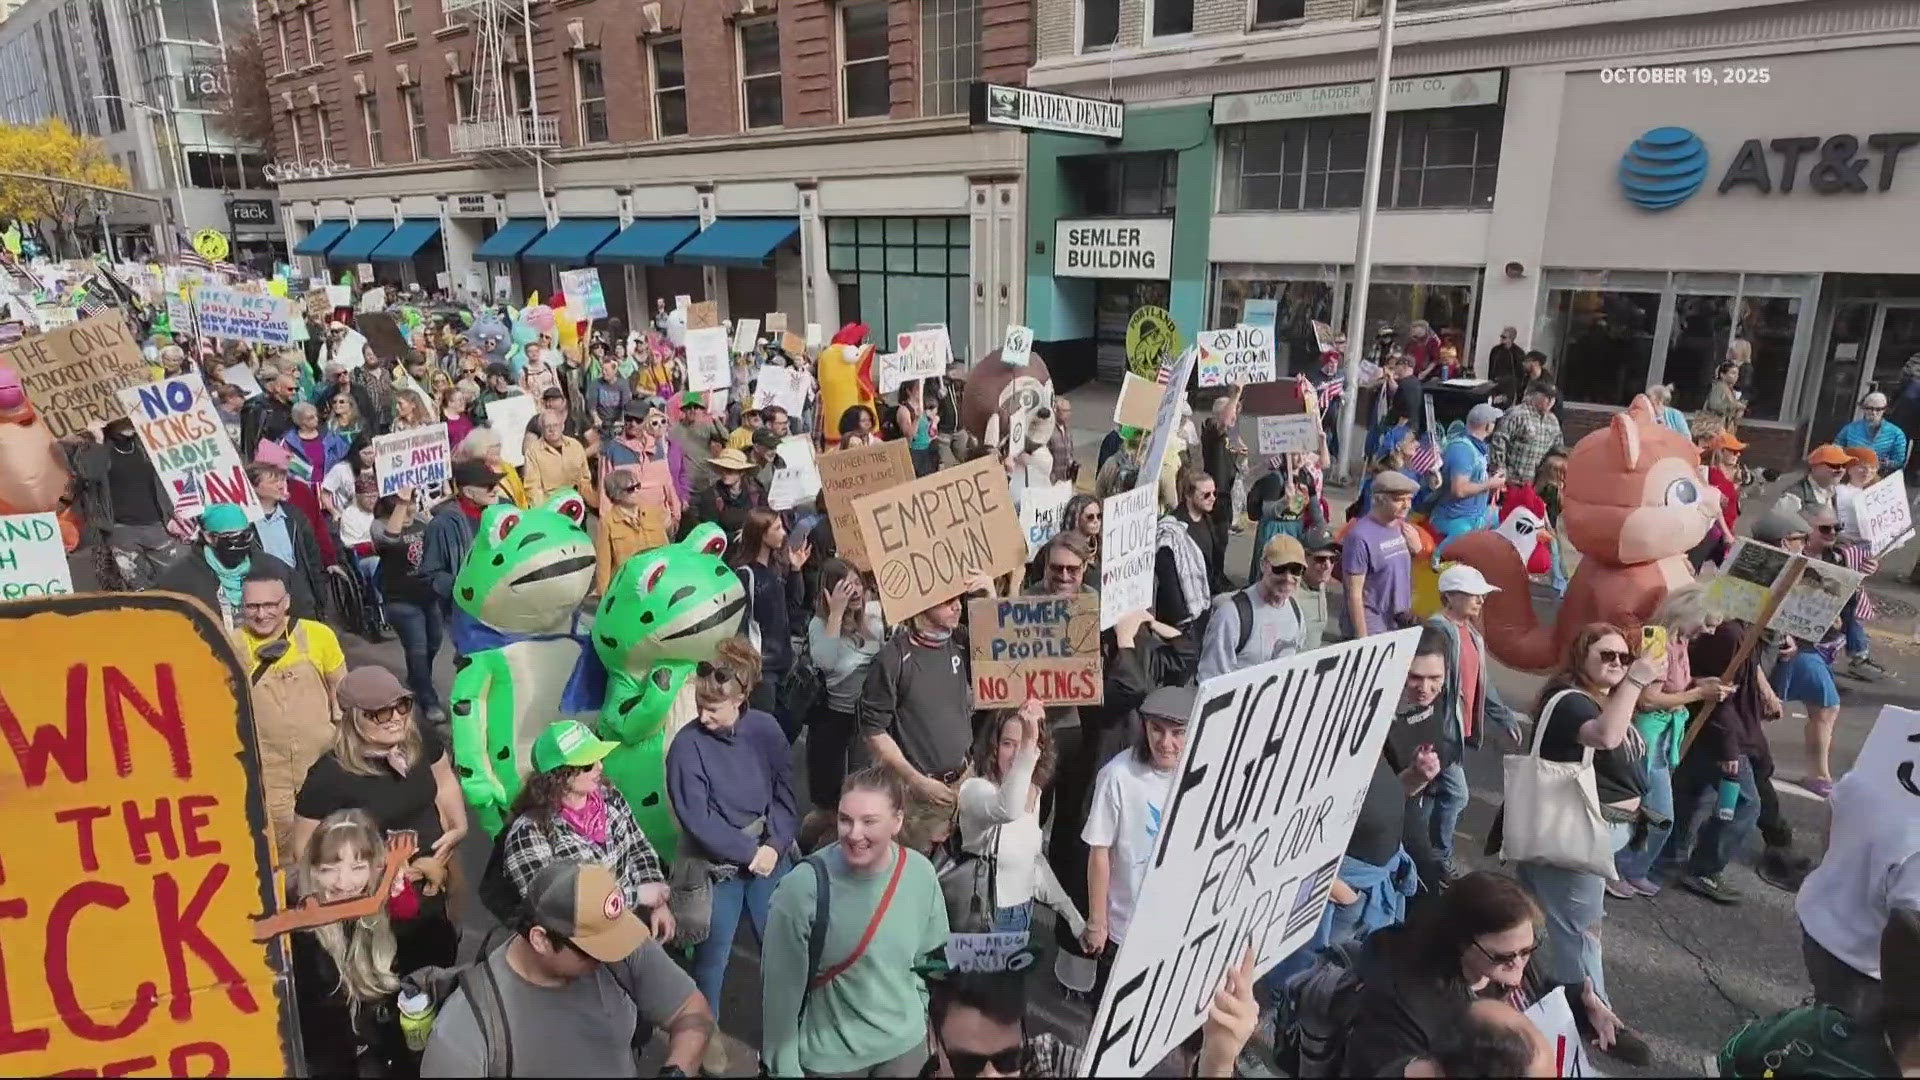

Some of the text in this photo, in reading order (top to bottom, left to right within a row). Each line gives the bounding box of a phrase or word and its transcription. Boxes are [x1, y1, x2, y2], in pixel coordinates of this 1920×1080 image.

[1254, 92, 1302, 106] JACOB'S
[1311, 86, 1361, 100] LADDER
[1422, 79, 1446, 91] CO.
[1021, 92, 1073, 123] HAYDEN
[1076, 101, 1121, 129] DENTAL
[1717, 131, 1920, 195] AT&T
[233, 203, 269, 219] rack
[1068, 228, 1141, 247] SEMLER
[1067, 250, 1156, 269] BUILDING
[201, 303, 257, 319] DONALD
[260, 312, 272, 322] J
[242, 299, 278, 312] HEY
[1130, 305, 1176, 333] PORTLAND
[222, 325, 240, 335] YOU
[260, 320, 289, 330] GIRLS
[1236, 328, 1264, 349] NO
[10, 321, 126, 372] THE ONLY
[1223, 348, 1271, 365] CROWN
[21, 358, 98, 397] MINORITY
[95, 352, 121, 373] YOU
[1224, 370, 1269, 386] CLWN
[32, 384, 93, 415] WORRY
[138, 381, 194, 420] NO
[139, 410, 217, 450] KINGS
[156, 438, 221, 472] ABOVE
[181, 461, 217, 476] THE
[391, 445, 448, 469] IS ANTI-
[869, 452, 888, 463] THE
[383, 462, 445, 495] AMERICAN
[872, 470, 999, 554] EMPIRE
[1870, 501, 1905, 537] PRESS
[1107, 513, 1155, 562] I LOVE
[909, 519, 994, 597] DOWN
[1109, 566, 1124, 583] MY
[997, 600, 1071, 629] POWER
[1014, 627, 1031, 638] TO
[991, 637, 1072, 662] PEOPLE
[951, 655, 961, 675] P
[978, 668, 1096, 701] NO KINGS
[1155, 640, 1396, 870] FIGHTING
[55, 794, 222, 873] THE
[1183, 826, 1270, 936] FOR
[1273, 793, 1335, 868] OUR
[955, 937, 973, 950] IN
[1087, 875, 1299, 1078] FUTURE
